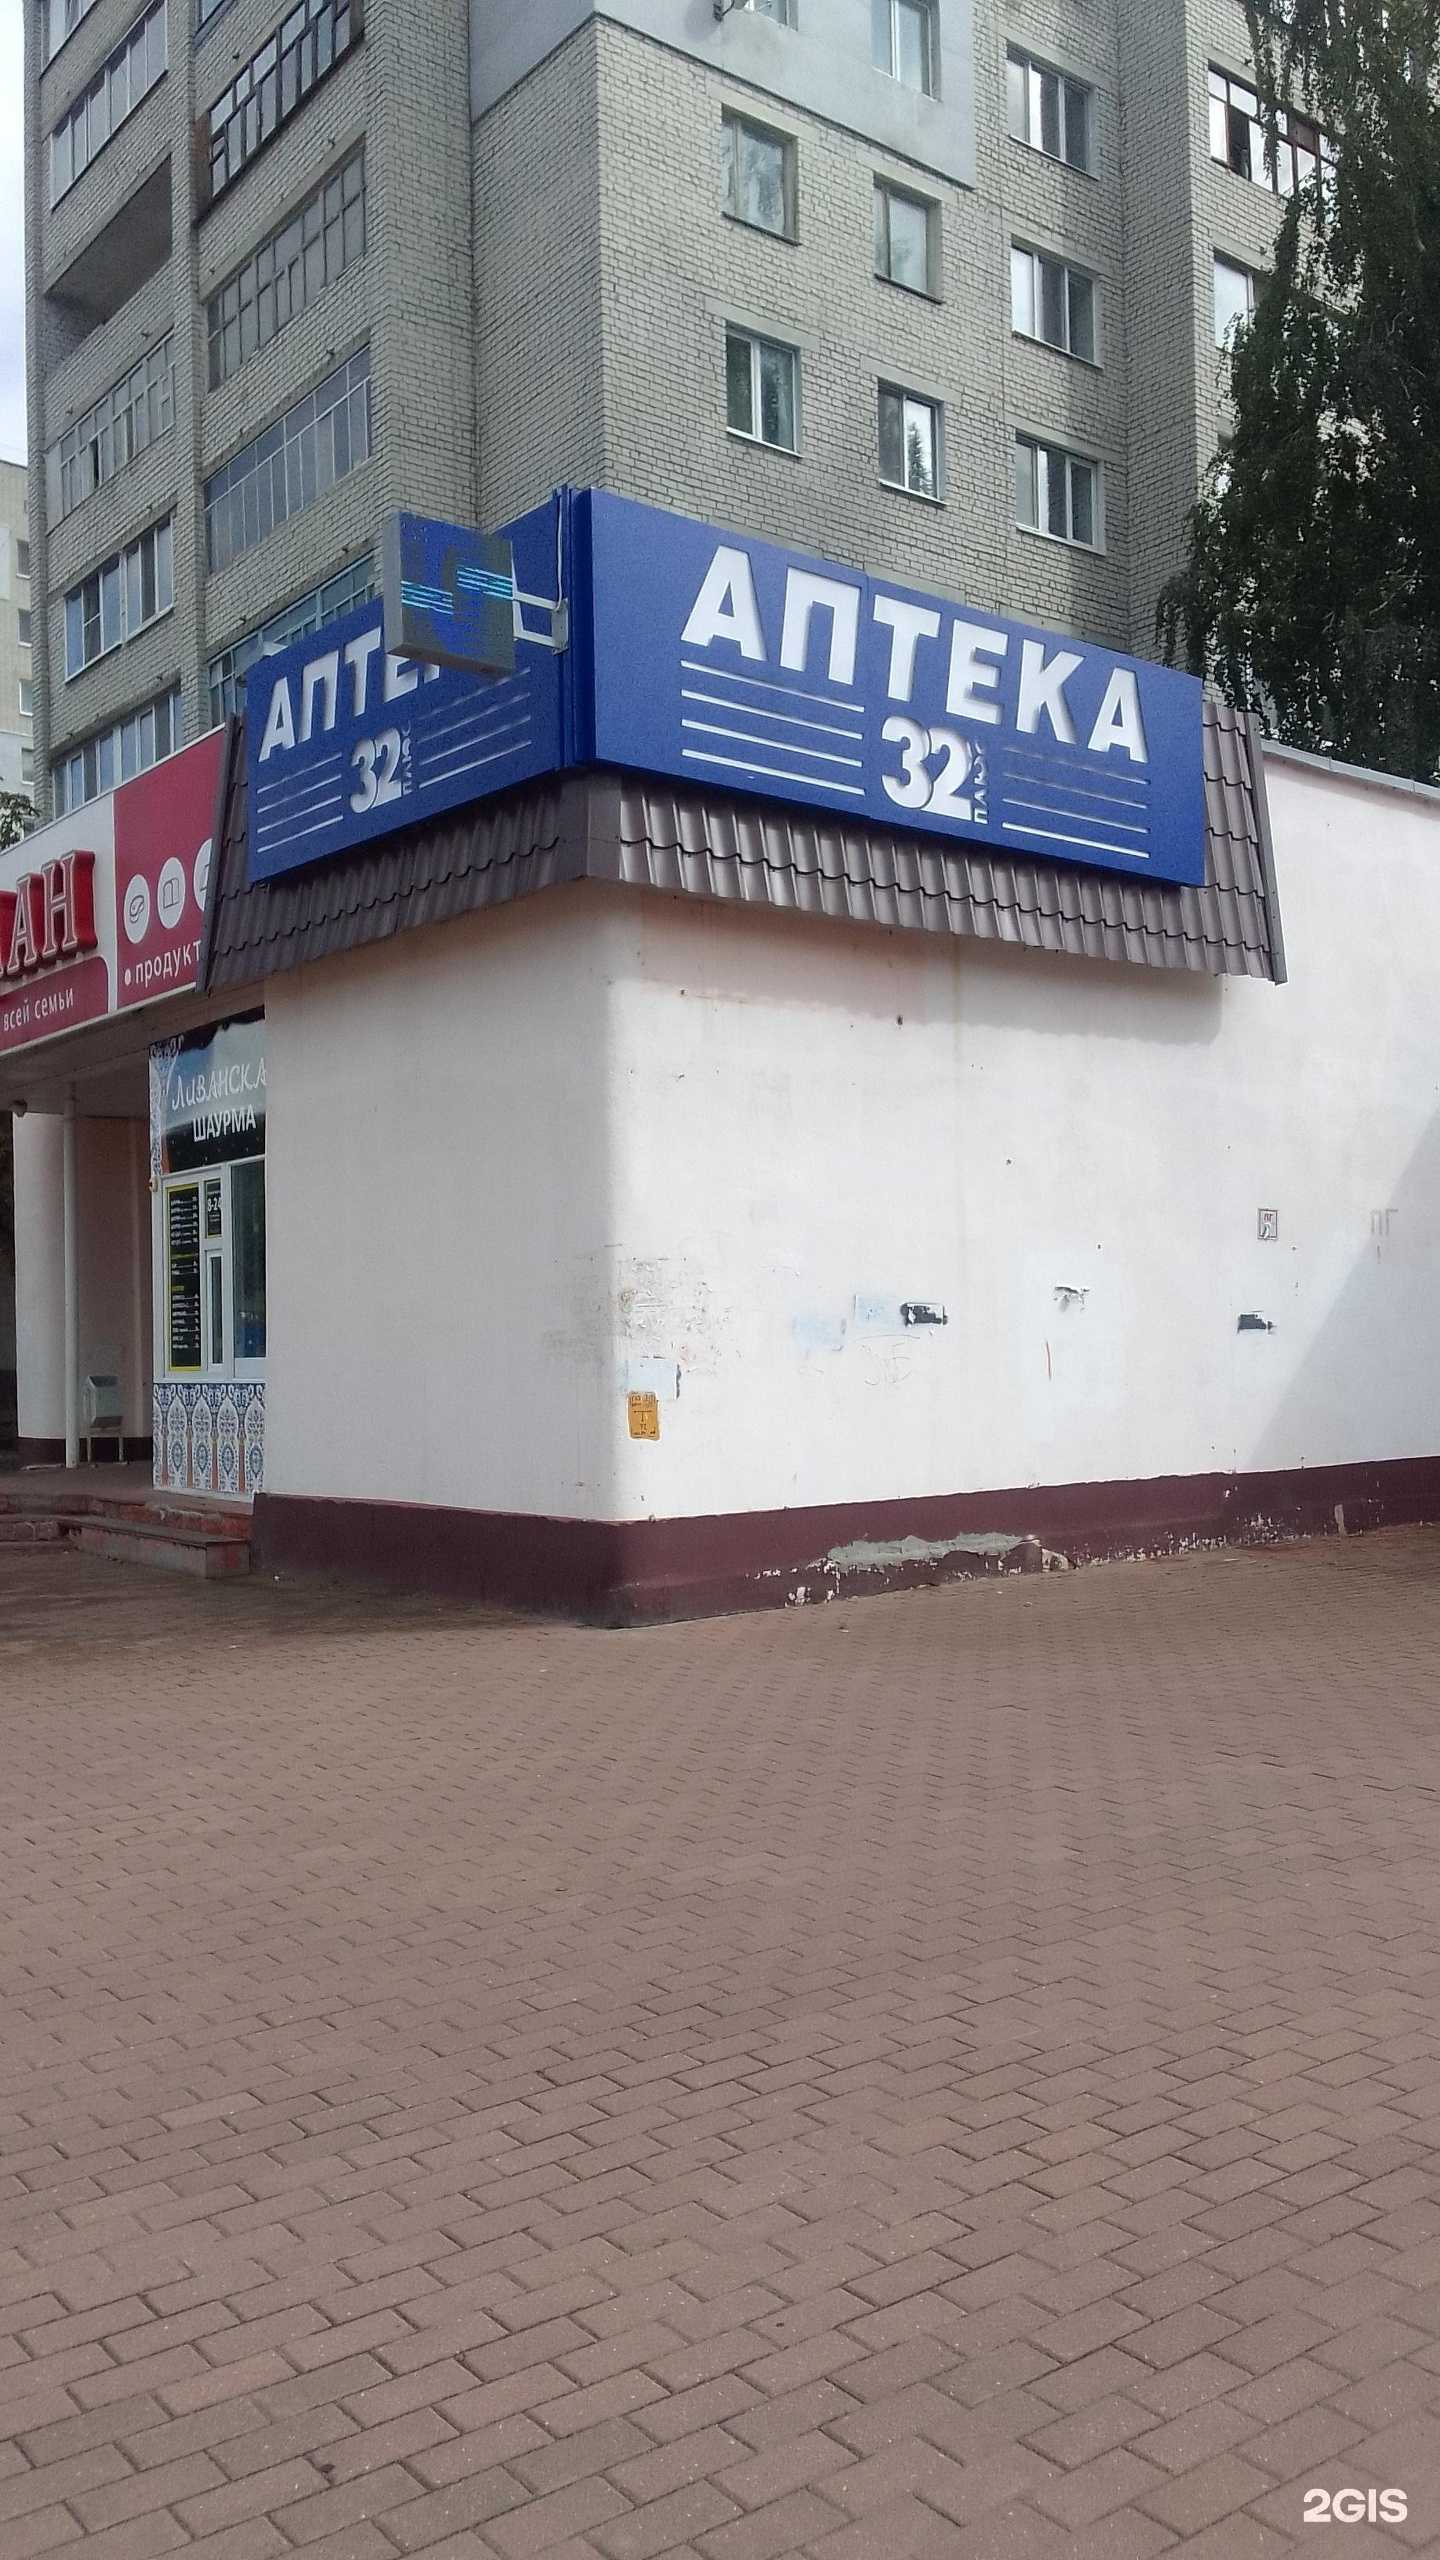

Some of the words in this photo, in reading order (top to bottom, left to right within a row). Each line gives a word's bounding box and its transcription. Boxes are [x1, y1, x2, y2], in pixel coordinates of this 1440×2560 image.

[258, 627, 440, 764] АПТЕ
[680, 544, 1149, 764] АПТЕКА
[349, 726, 402, 814] 32
[880, 715, 973, 822] 32
[0, 849, 97, 979] АН
[3, 997, 30, 1032] всей
[34, 987, 74, 1021] семьи
[192, 1103, 257, 1143] ШАУРМА
